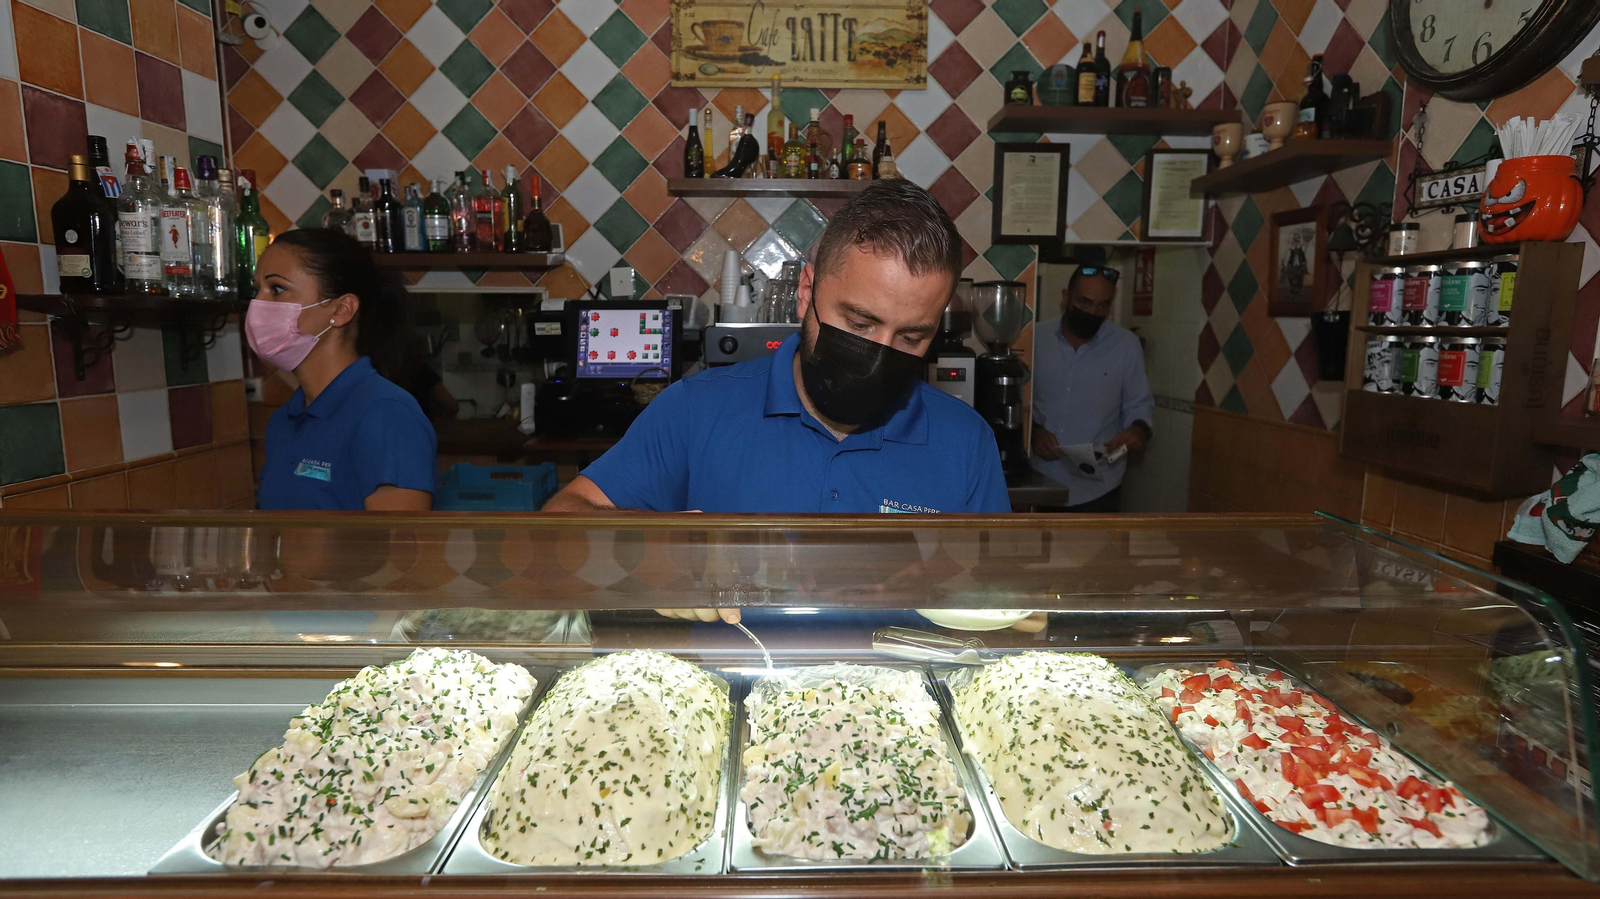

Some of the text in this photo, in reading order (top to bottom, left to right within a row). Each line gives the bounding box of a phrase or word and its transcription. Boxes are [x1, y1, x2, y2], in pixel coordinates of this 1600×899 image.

[785, 12, 859, 62] LATTE
[1420, 14, 1436, 43] 8
[1443, 34, 1458, 64] 7
[1472, 31, 1493, 66] 6
[1427, 174, 1479, 199] CASA
[120, 219, 148, 228] ewar's
[883, 498, 900, 508] BAR
[901, 503, 923, 513] CASA
